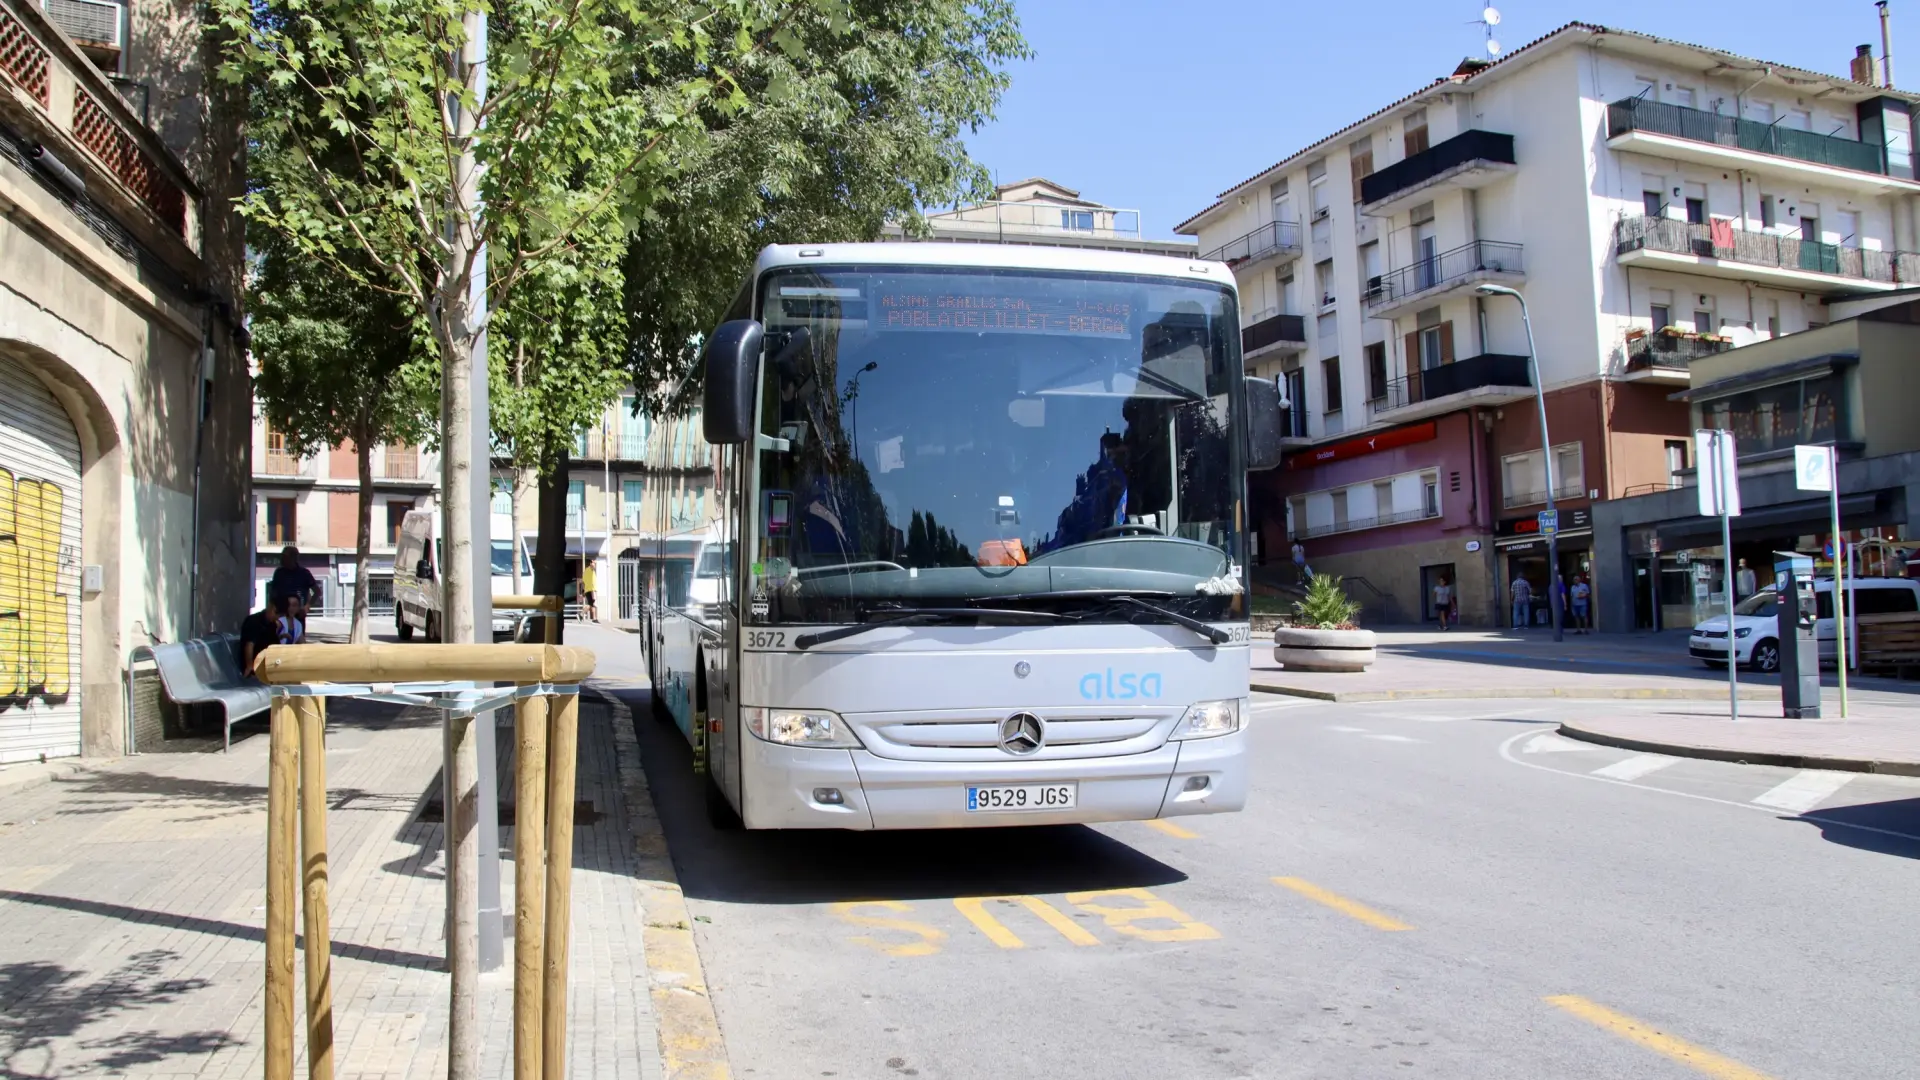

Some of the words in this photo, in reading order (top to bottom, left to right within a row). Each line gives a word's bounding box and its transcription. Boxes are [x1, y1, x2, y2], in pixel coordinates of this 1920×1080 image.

[1541, 519, 1557, 527] TAXI
[747, 631, 785, 648] 3672
[1080, 666, 1162, 700] alsa
[978, 788, 1027, 807] 9529
[1034, 787, 1069, 805] JGS
[827, 887, 1223, 957] BUS
